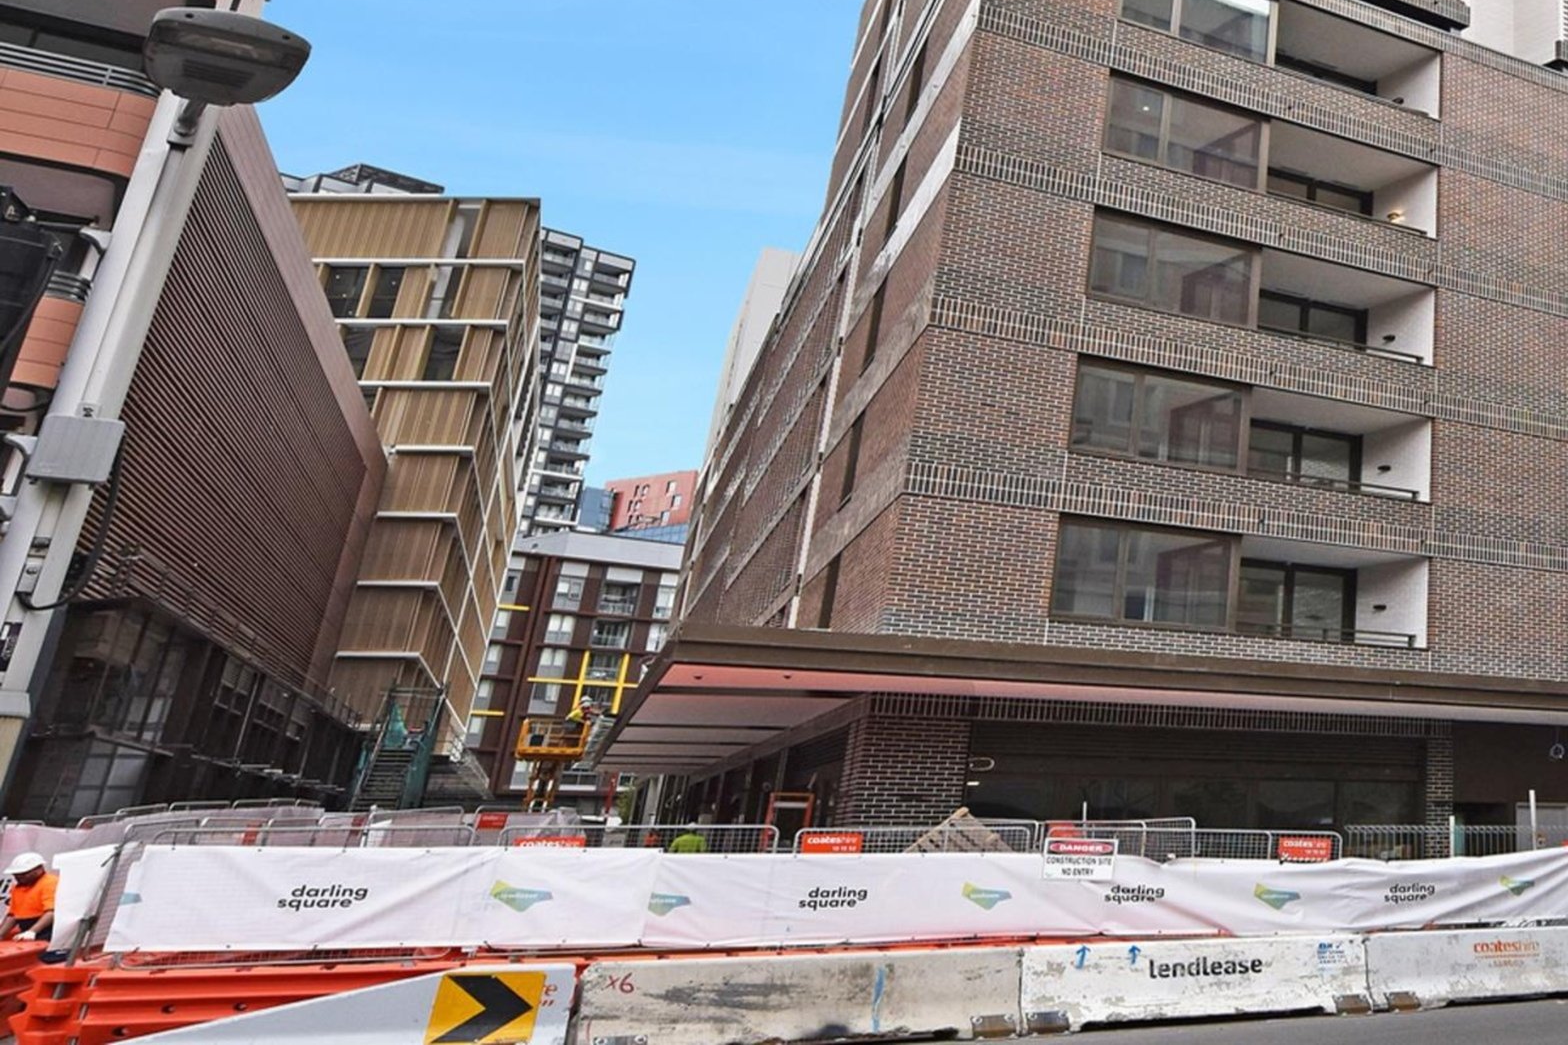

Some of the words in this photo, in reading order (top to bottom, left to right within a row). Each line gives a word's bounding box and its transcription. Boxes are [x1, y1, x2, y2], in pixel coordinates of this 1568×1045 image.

[1059, 844, 1104, 853] DANGER
[1046, 856, 1096, 865] CONSTRUCTION
[1098, 858, 1112, 866] SITE
[1061, 868, 1071, 876] NO
[1072, 868, 1094, 876] ENTRY
[290, 883, 369, 901] darling
[808, 886, 868, 901] darling
[1111, 884, 1165, 898] darling
[1389, 882, 1435, 896] darling
[277, 898, 352, 912] square
[798, 899, 857, 912] square
[1104, 894, 1155, 905] square
[1384, 893, 1427, 907] square
[1149, 956, 1263, 979] lendlease
